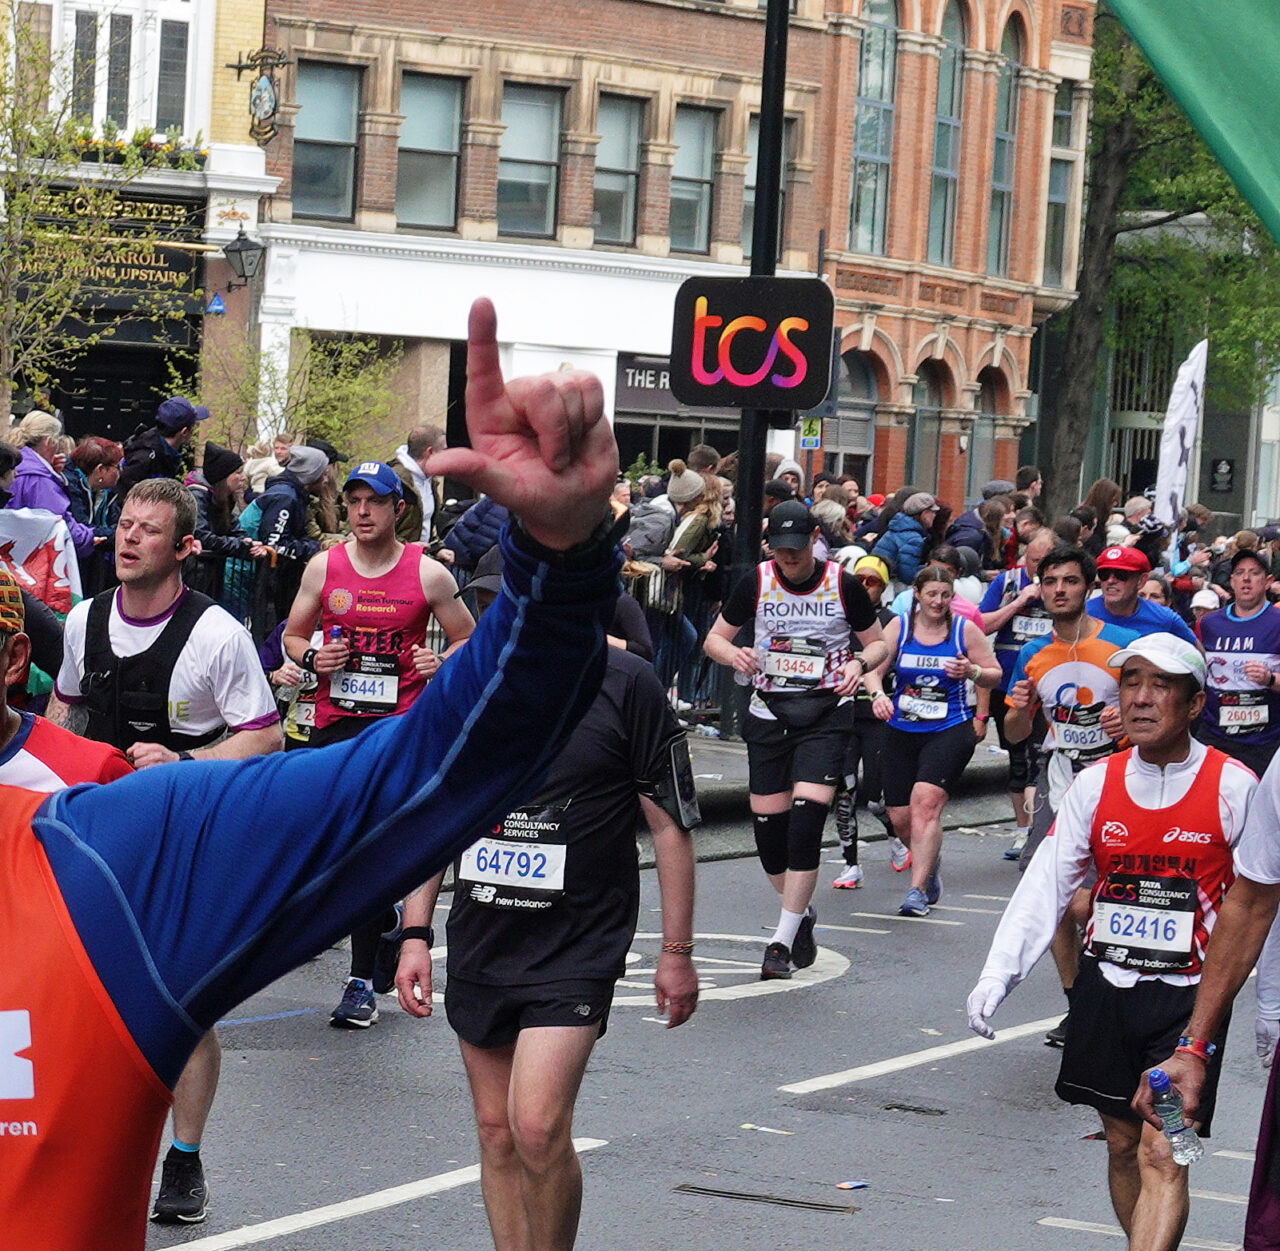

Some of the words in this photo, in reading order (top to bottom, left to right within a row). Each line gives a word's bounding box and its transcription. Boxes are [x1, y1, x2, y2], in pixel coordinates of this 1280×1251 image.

[121, 268, 187, 283] UPSTAIRS
[691, 296, 809, 388] tcs
[626, 369, 656, 389] THE
[358, 595, 381, 604] Brain
[382, 597, 414, 606] Tumour
[356, 603, 396, 613] Research
[763, 602, 836, 617] RONNIE
[1215, 636, 1254, 651] LIAM
[775, 658, 814, 674] 13454
[916, 657, 940, 668] LISA
[341, 677, 385, 697] 56441
[504, 820, 560, 831] CONSULTANCY
[503, 829, 539, 838] SERVICES
[1178, 830, 1212, 844] asics
[476, 847, 547, 878] 64792
[1101, 881, 1136, 901] tcs
[1139, 881, 1161, 889] TATA
[1139, 888, 1191, 900] CONSULTANCY
[1139, 895, 1171, 906] SERVICES
[495, 897, 514, 906] new
[1110, 912, 1177, 942] 62416
[1127, 958, 1143, 967] new
